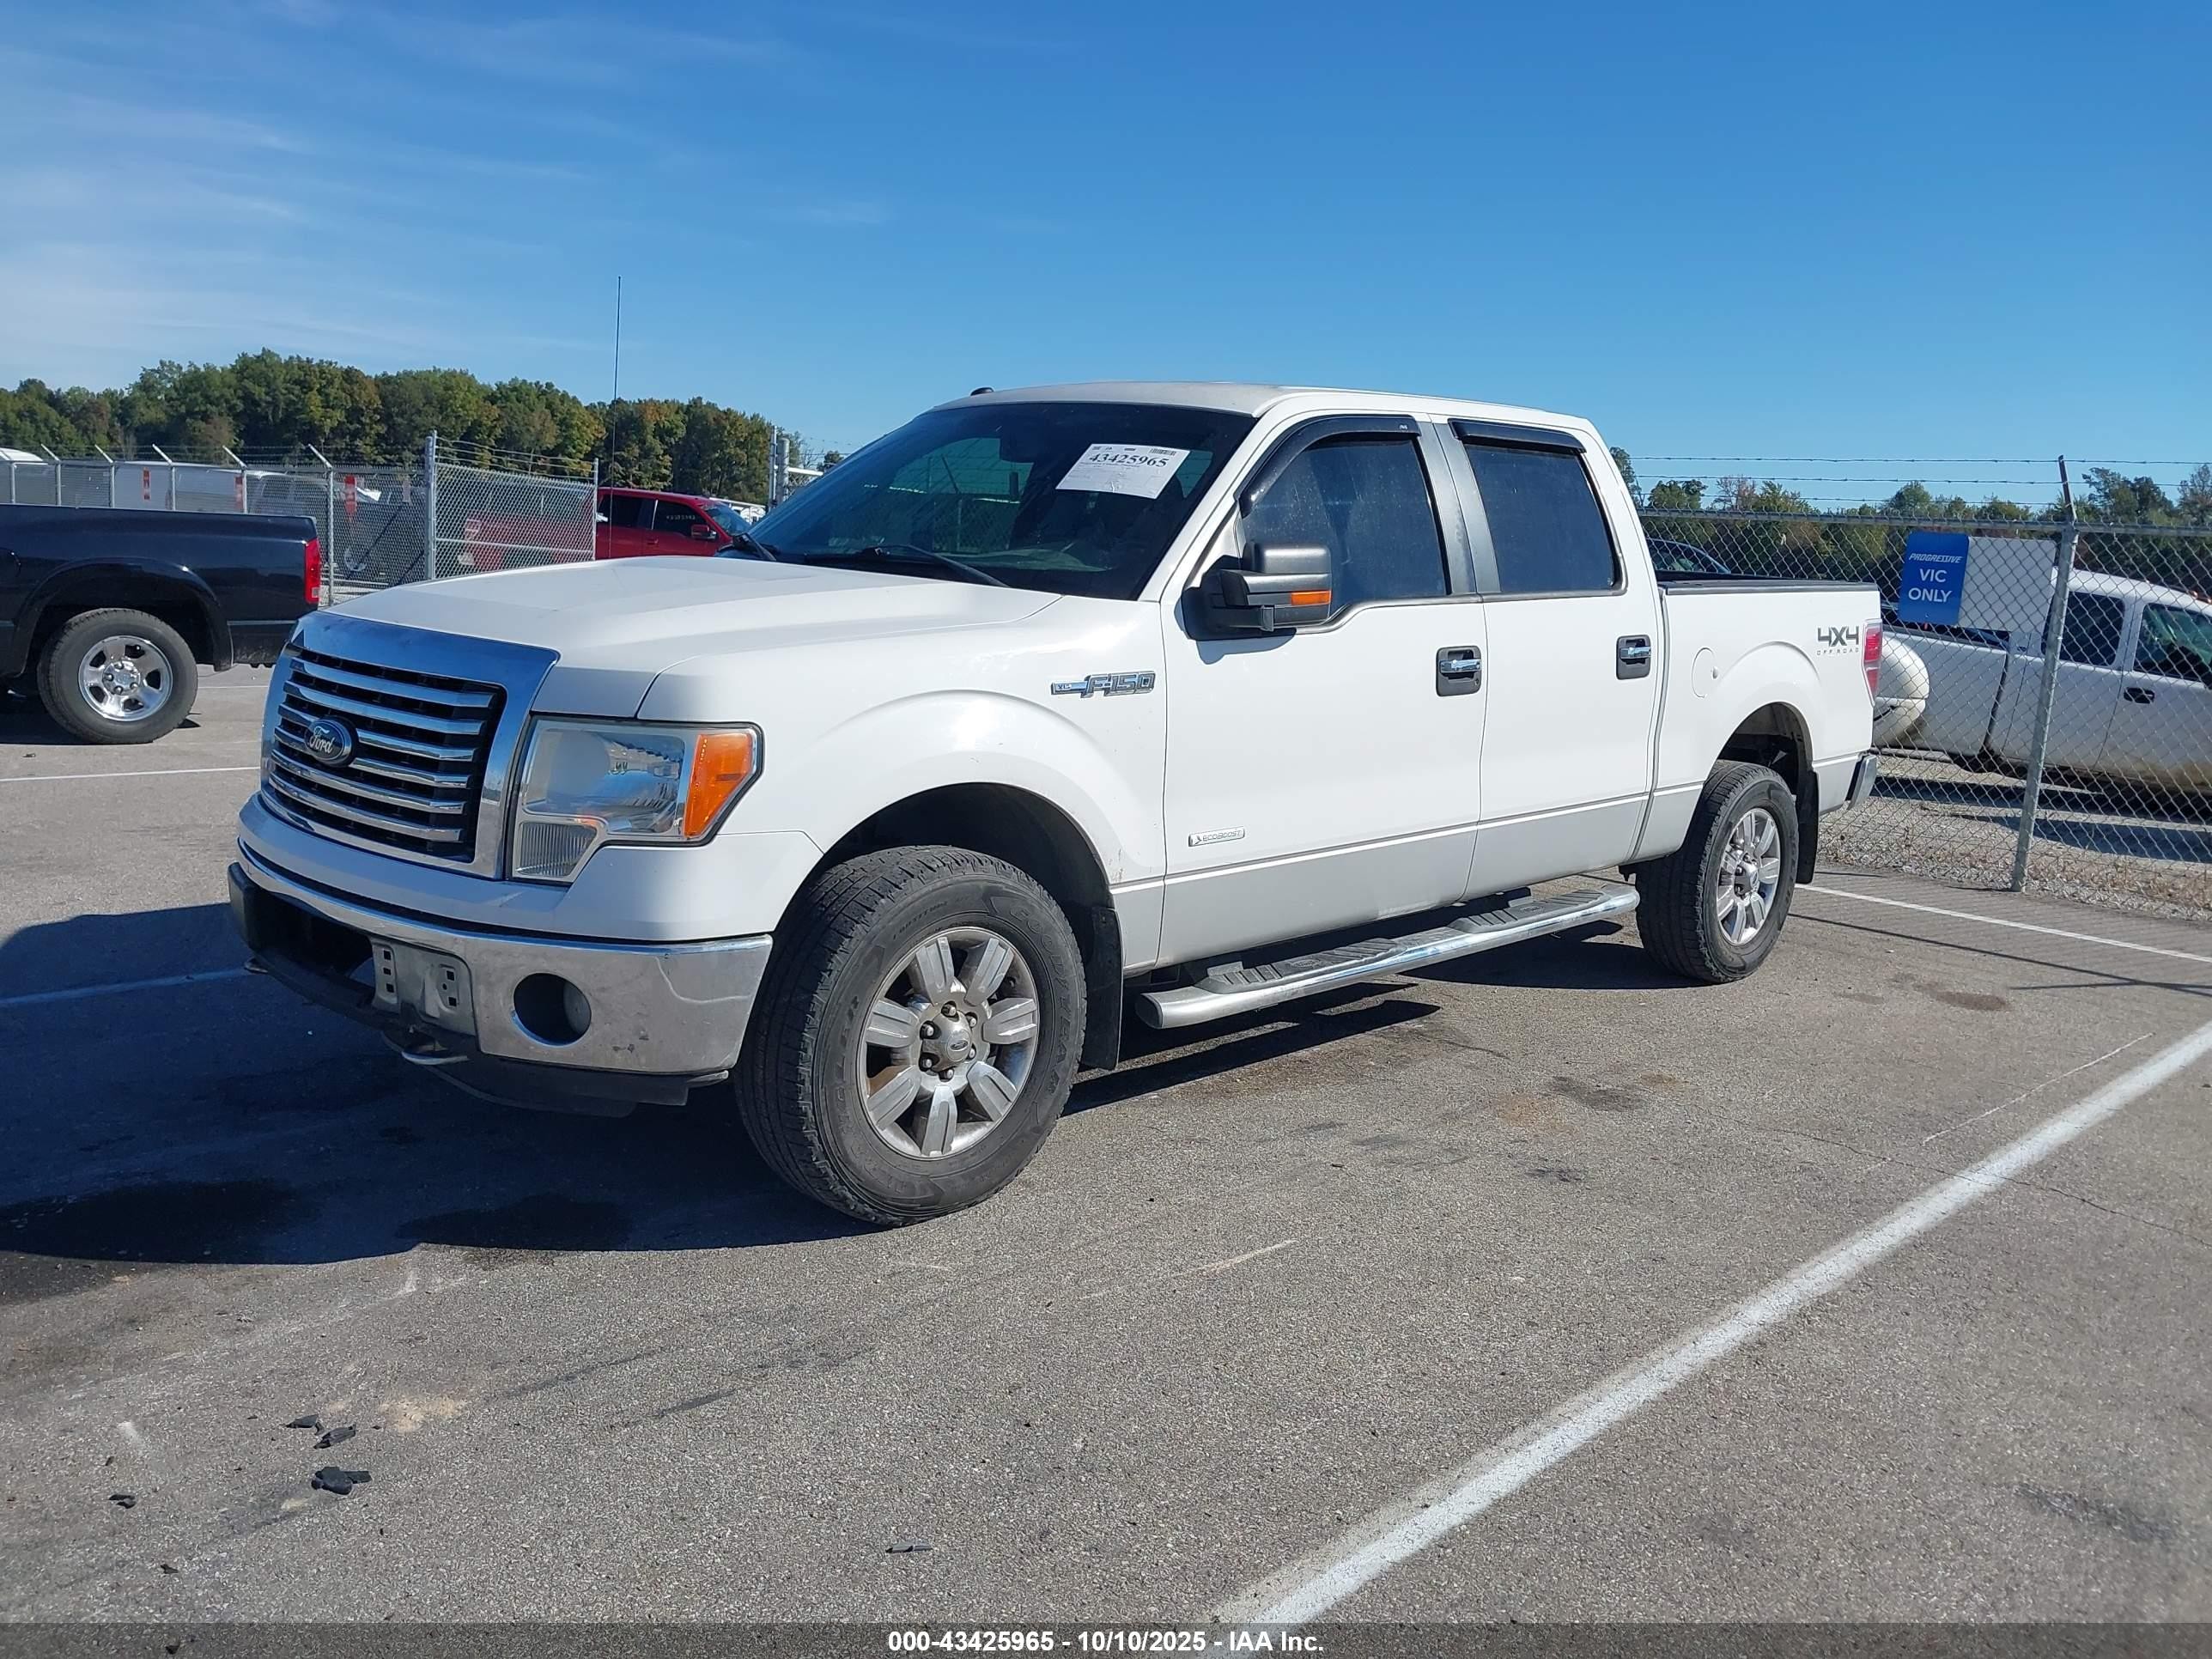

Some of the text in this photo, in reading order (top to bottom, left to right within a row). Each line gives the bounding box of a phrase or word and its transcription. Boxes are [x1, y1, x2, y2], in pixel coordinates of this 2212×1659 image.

[1089, 453, 1170, 468] 43425965
[1908, 552, 1964, 563] PROGRESSIVE
[1919, 568, 1948, 583] VIC
[1908, 587, 1953, 603] ONLY
[309, 726, 336, 754] Ford
